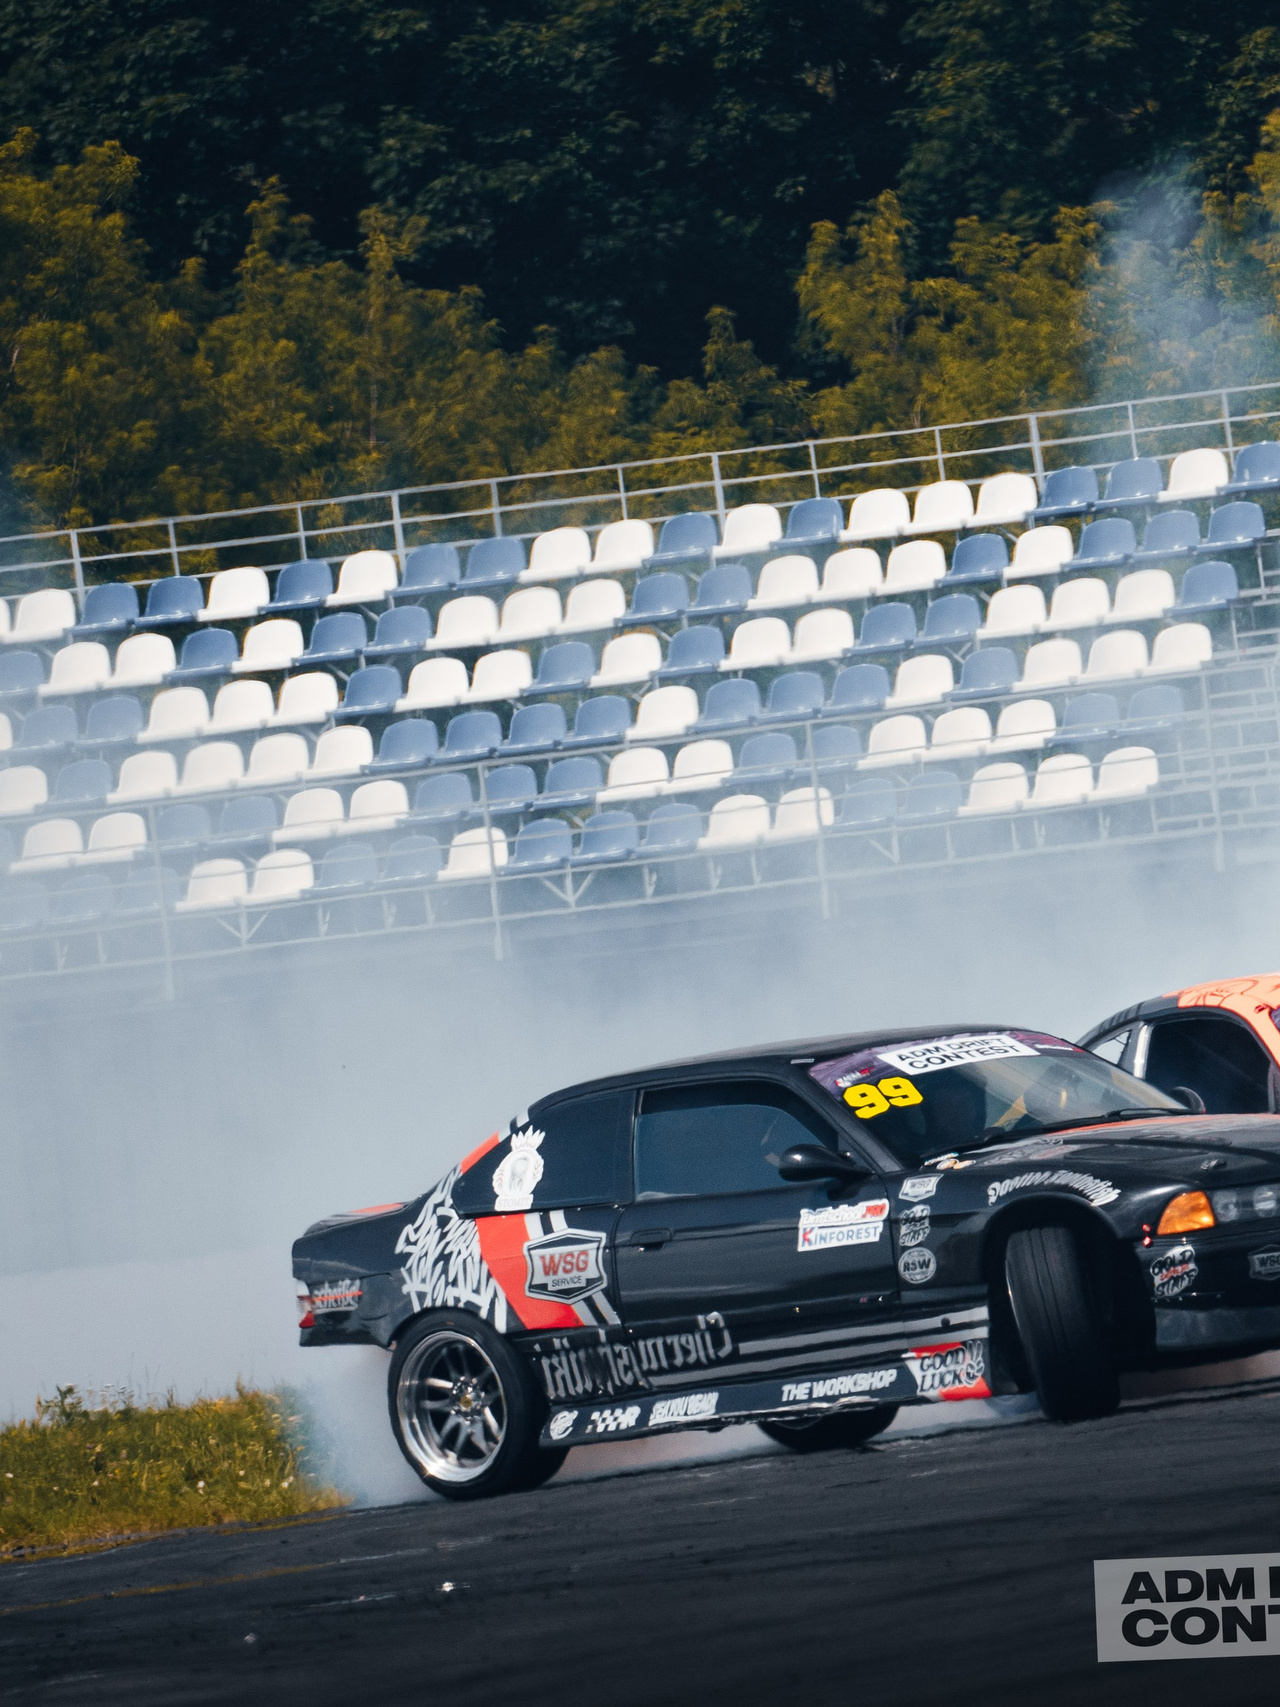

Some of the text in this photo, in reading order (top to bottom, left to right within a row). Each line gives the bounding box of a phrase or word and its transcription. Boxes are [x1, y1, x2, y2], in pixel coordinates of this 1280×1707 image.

[896, 1036, 1008, 1062] ADM DRIFT
[907, 1043, 1022, 1070] CONTEST
[843, 1076, 924, 1119] 99
[801, 1226, 880, 1247] KINFOREST
[540, 1250, 590, 1277] WSG
[551, 1275, 583, 1288] SERVICE
[919, 1347, 966, 1373] GOOD
[781, 1369, 898, 1402] THE WORKSHOP
[917, 1369, 964, 1393] LUCK
